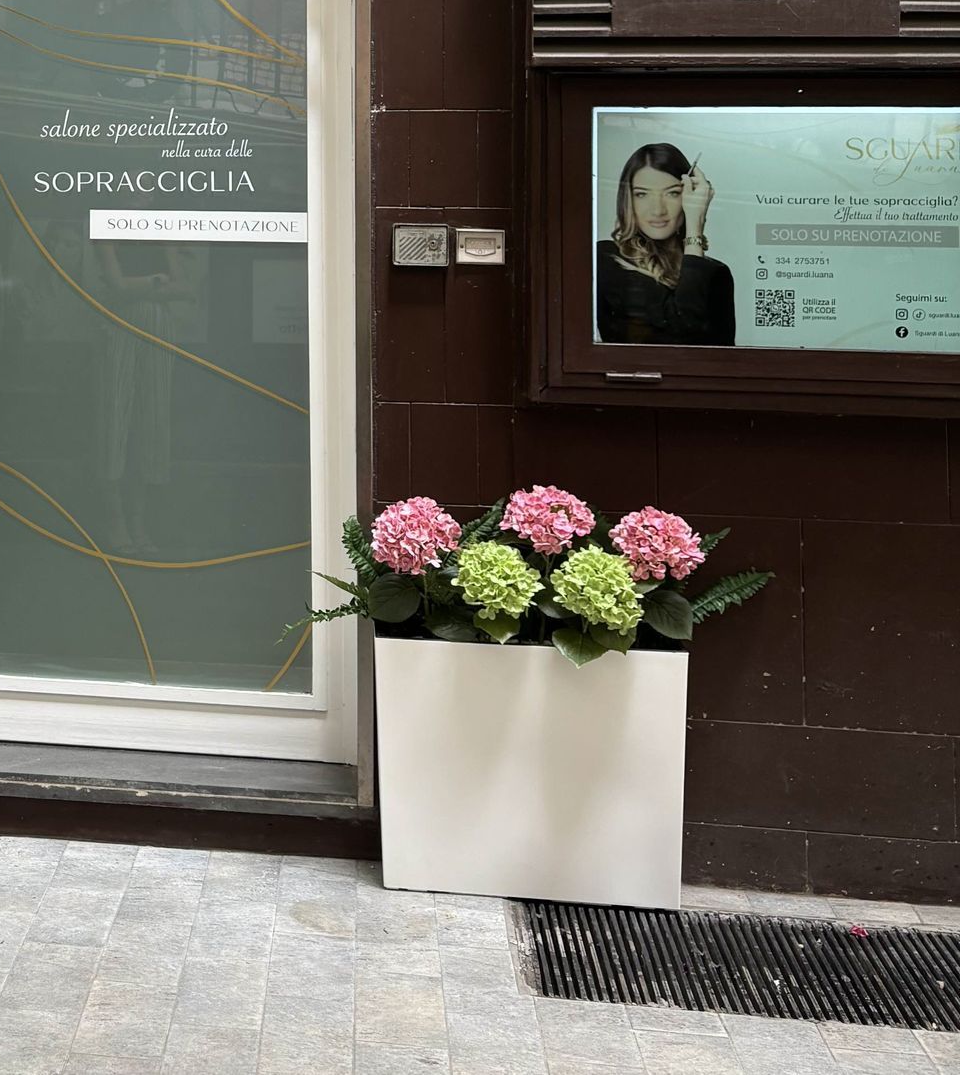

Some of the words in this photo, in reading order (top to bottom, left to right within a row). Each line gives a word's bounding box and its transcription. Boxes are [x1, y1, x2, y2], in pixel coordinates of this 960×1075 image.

[40, 109, 100, 139] salone
[106, 107, 229, 144] specializzato
[161, 140, 191, 158] nella
[194, 146, 222, 158] cura
[225, 139, 253, 158] delle
[845, 135, 960, 162] SGUAR
[34, 170, 256, 193] SOPRACCIGLIA
[755, 194, 784, 205] Vuoi
[787, 196, 830, 205] curare
[834, 195, 845, 205] le
[849, 196, 869, 206] tue
[873, 195, 959, 209] sopracciglia?
[833, 206, 873, 223] Effettua
[875, 207, 883, 221] il
[884, 212, 900, 221] tuo
[902, 211, 959, 222] trattamento
[107, 218, 149, 231] SOLO
[154, 219, 174, 231] SU
[178, 219, 300, 233] PRENOTAZIONE
[771, 228, 808, 241] SOLO
[811, 229, 830, 242] SU
[834, 229, 942, 243] PRENOTAZIONE
[775, 257, 790, 265] 334
[794, 257, 830, 265] 2753751
[775, 270, 834, 280] @sguardi.luana
[802, 298, 830, 306] Utilizza
[831, 298, 836, 306] il
[895, 293, 932, 304] Seguimi
[934, 295, 948, 303] su:
[802, 306, 814, 315] QR
[815, 306, 836, 314] CODE
